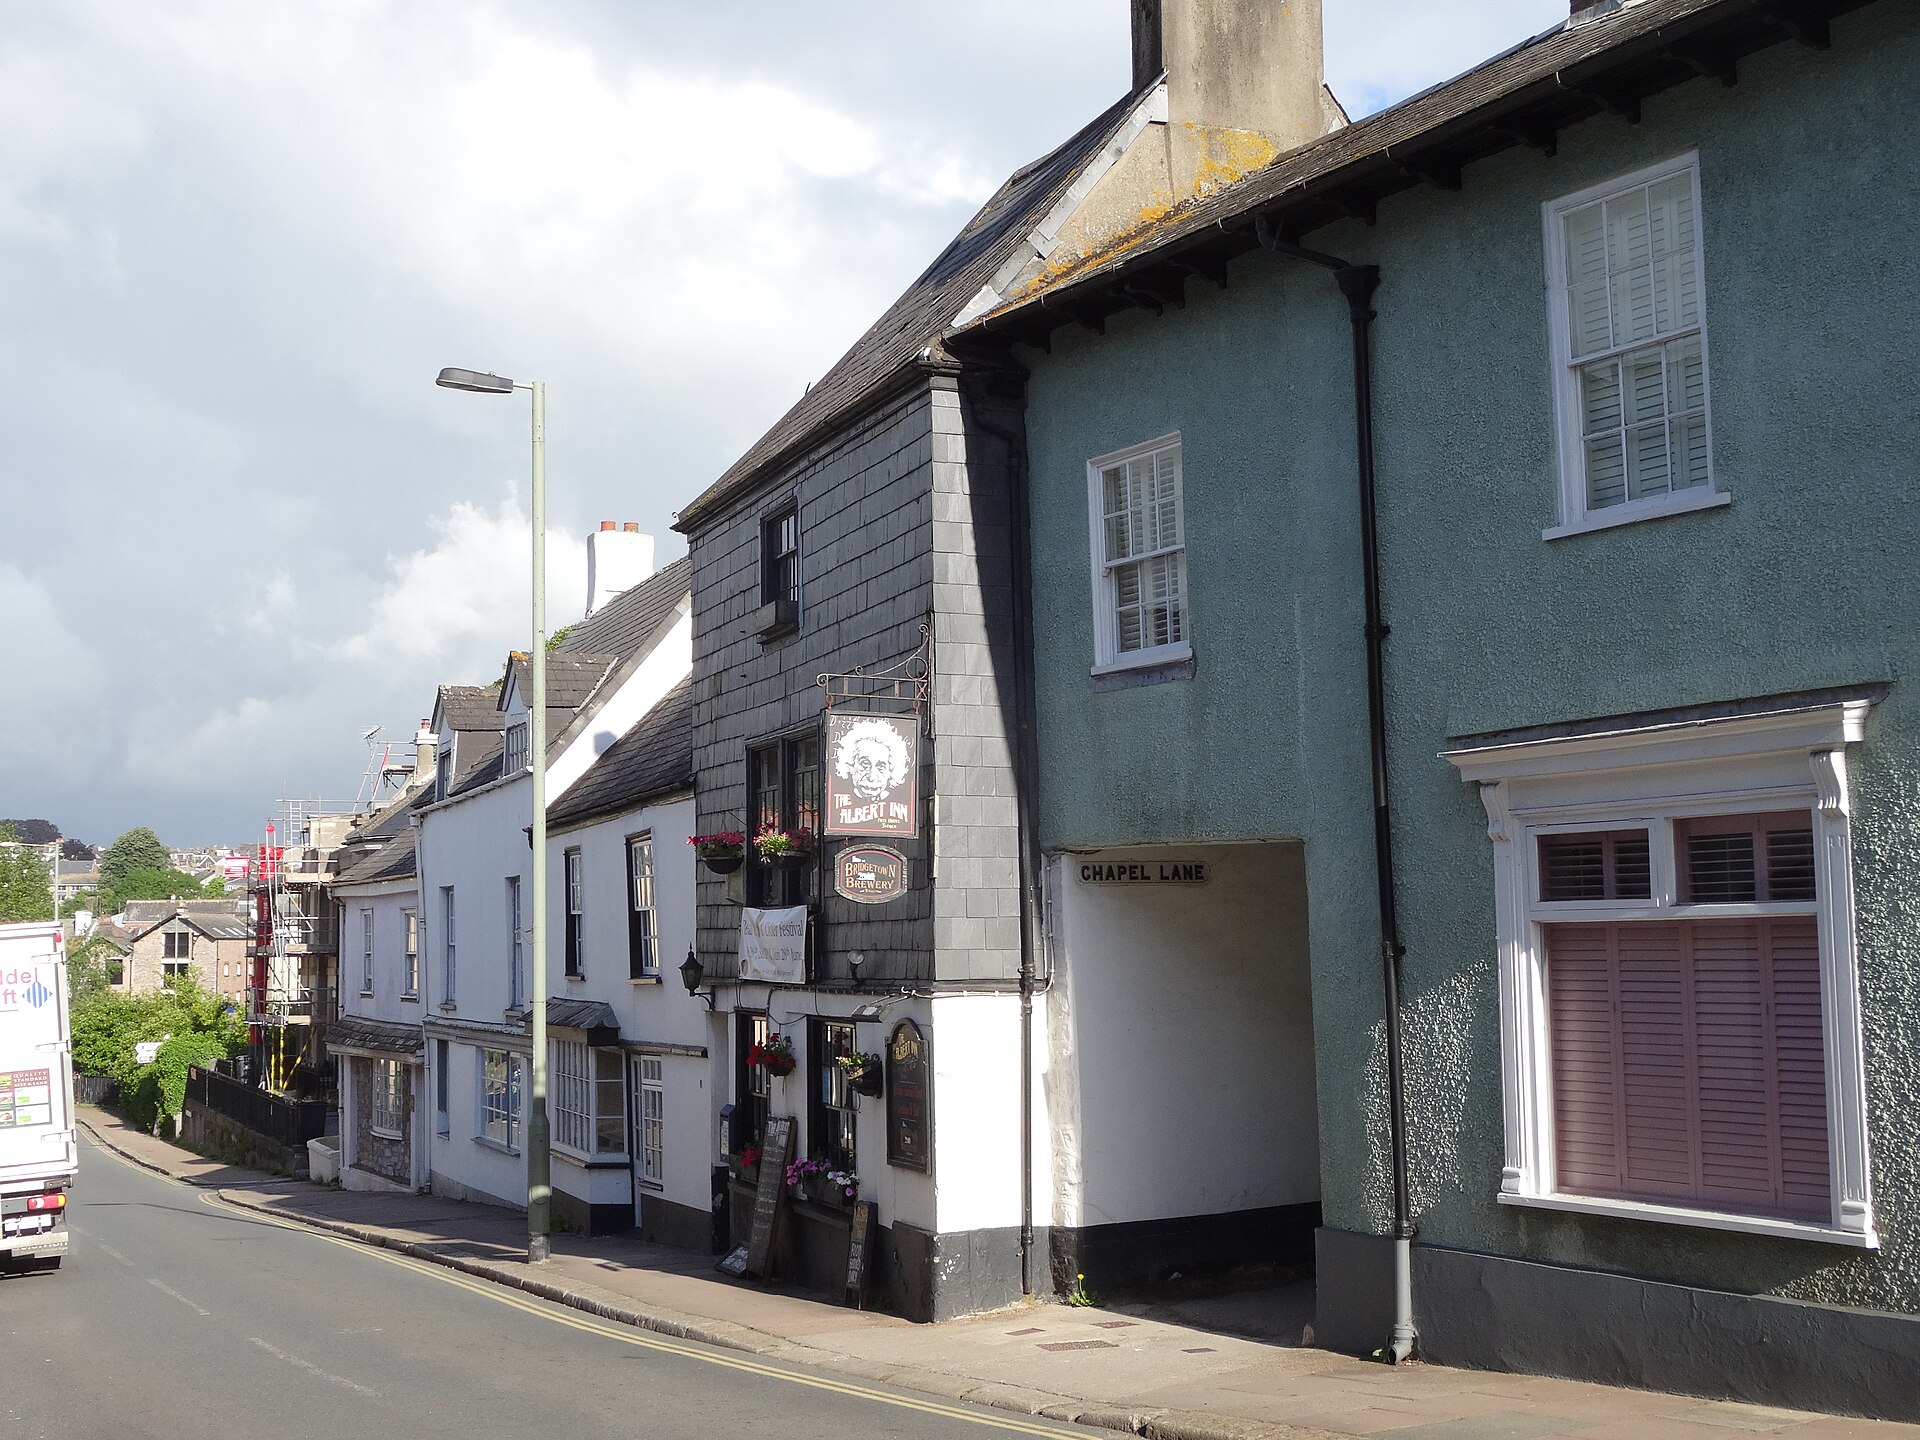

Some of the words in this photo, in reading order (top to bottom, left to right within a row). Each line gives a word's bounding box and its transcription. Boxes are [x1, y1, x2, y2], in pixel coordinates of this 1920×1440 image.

[834, 793, 852, 809] THE
[840, 802, 887, 823] ALBERT
[889, 802, 908, 822] INN
[845, 862, 896, 879] BRIDGETOWN
[1080, 865, 1151, 881] CHAPEL
[1159, 864, 1205, 881] LANE
[845, 877, 894, 889] BREWERY
[779, 920, 804, 937] Festival
[13, 1071, 47, 1079] QUALITY
